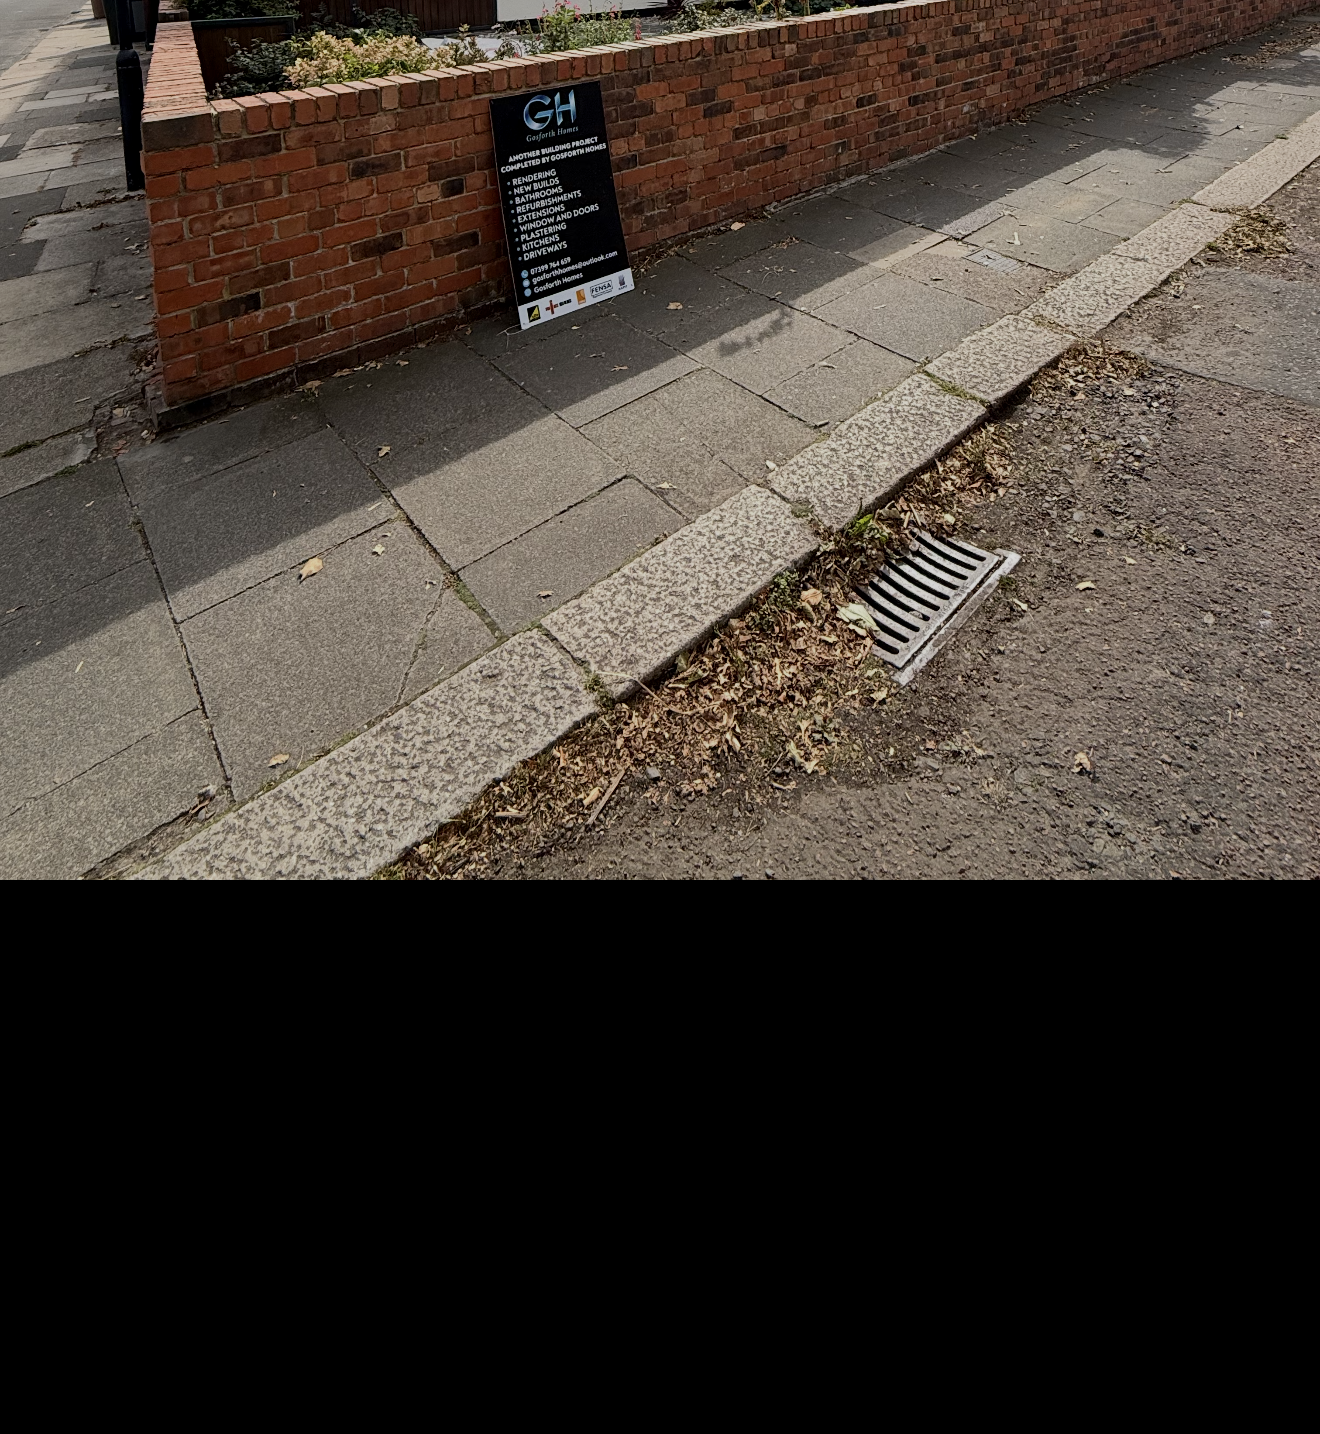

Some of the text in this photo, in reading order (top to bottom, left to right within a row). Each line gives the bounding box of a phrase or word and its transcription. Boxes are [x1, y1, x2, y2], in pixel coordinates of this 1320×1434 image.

[524, 89, 577, 130] GH
[526, 126, 578, 142] Gosforth Homes
[501, 143, 606, 173] COMPLETED BY GOSFORTH HOMES
[508, 136, 598, 162] ANOTHER BUILDING PROJECT
[512, 169, 556, 186] RENDERING
[514, 177, 559, 195] NEW BUILDS
[515, 186, 563, 204] BATHROOMS
[516, 190, 581, 214] REFURBISHMENTS
[518, 204, 565, 223] EXTENSIONS
[519, 203, 599, 232] WINDOW AND DOORS
[521, 222, 567, 242] PLASTERING
[522, 234, 560, 251] KITCHENS
[523, 241, 567, 260] DRIVEWAYS
[530, 264, 548, 275] 07399
[561, 257, 571, 265] 659
[532, 251, 618, 284] gosforthhomes@outlook.com
[534, 272, 583, 293] Gosforth Homes
[591, 283, 612, 293] FENSA
